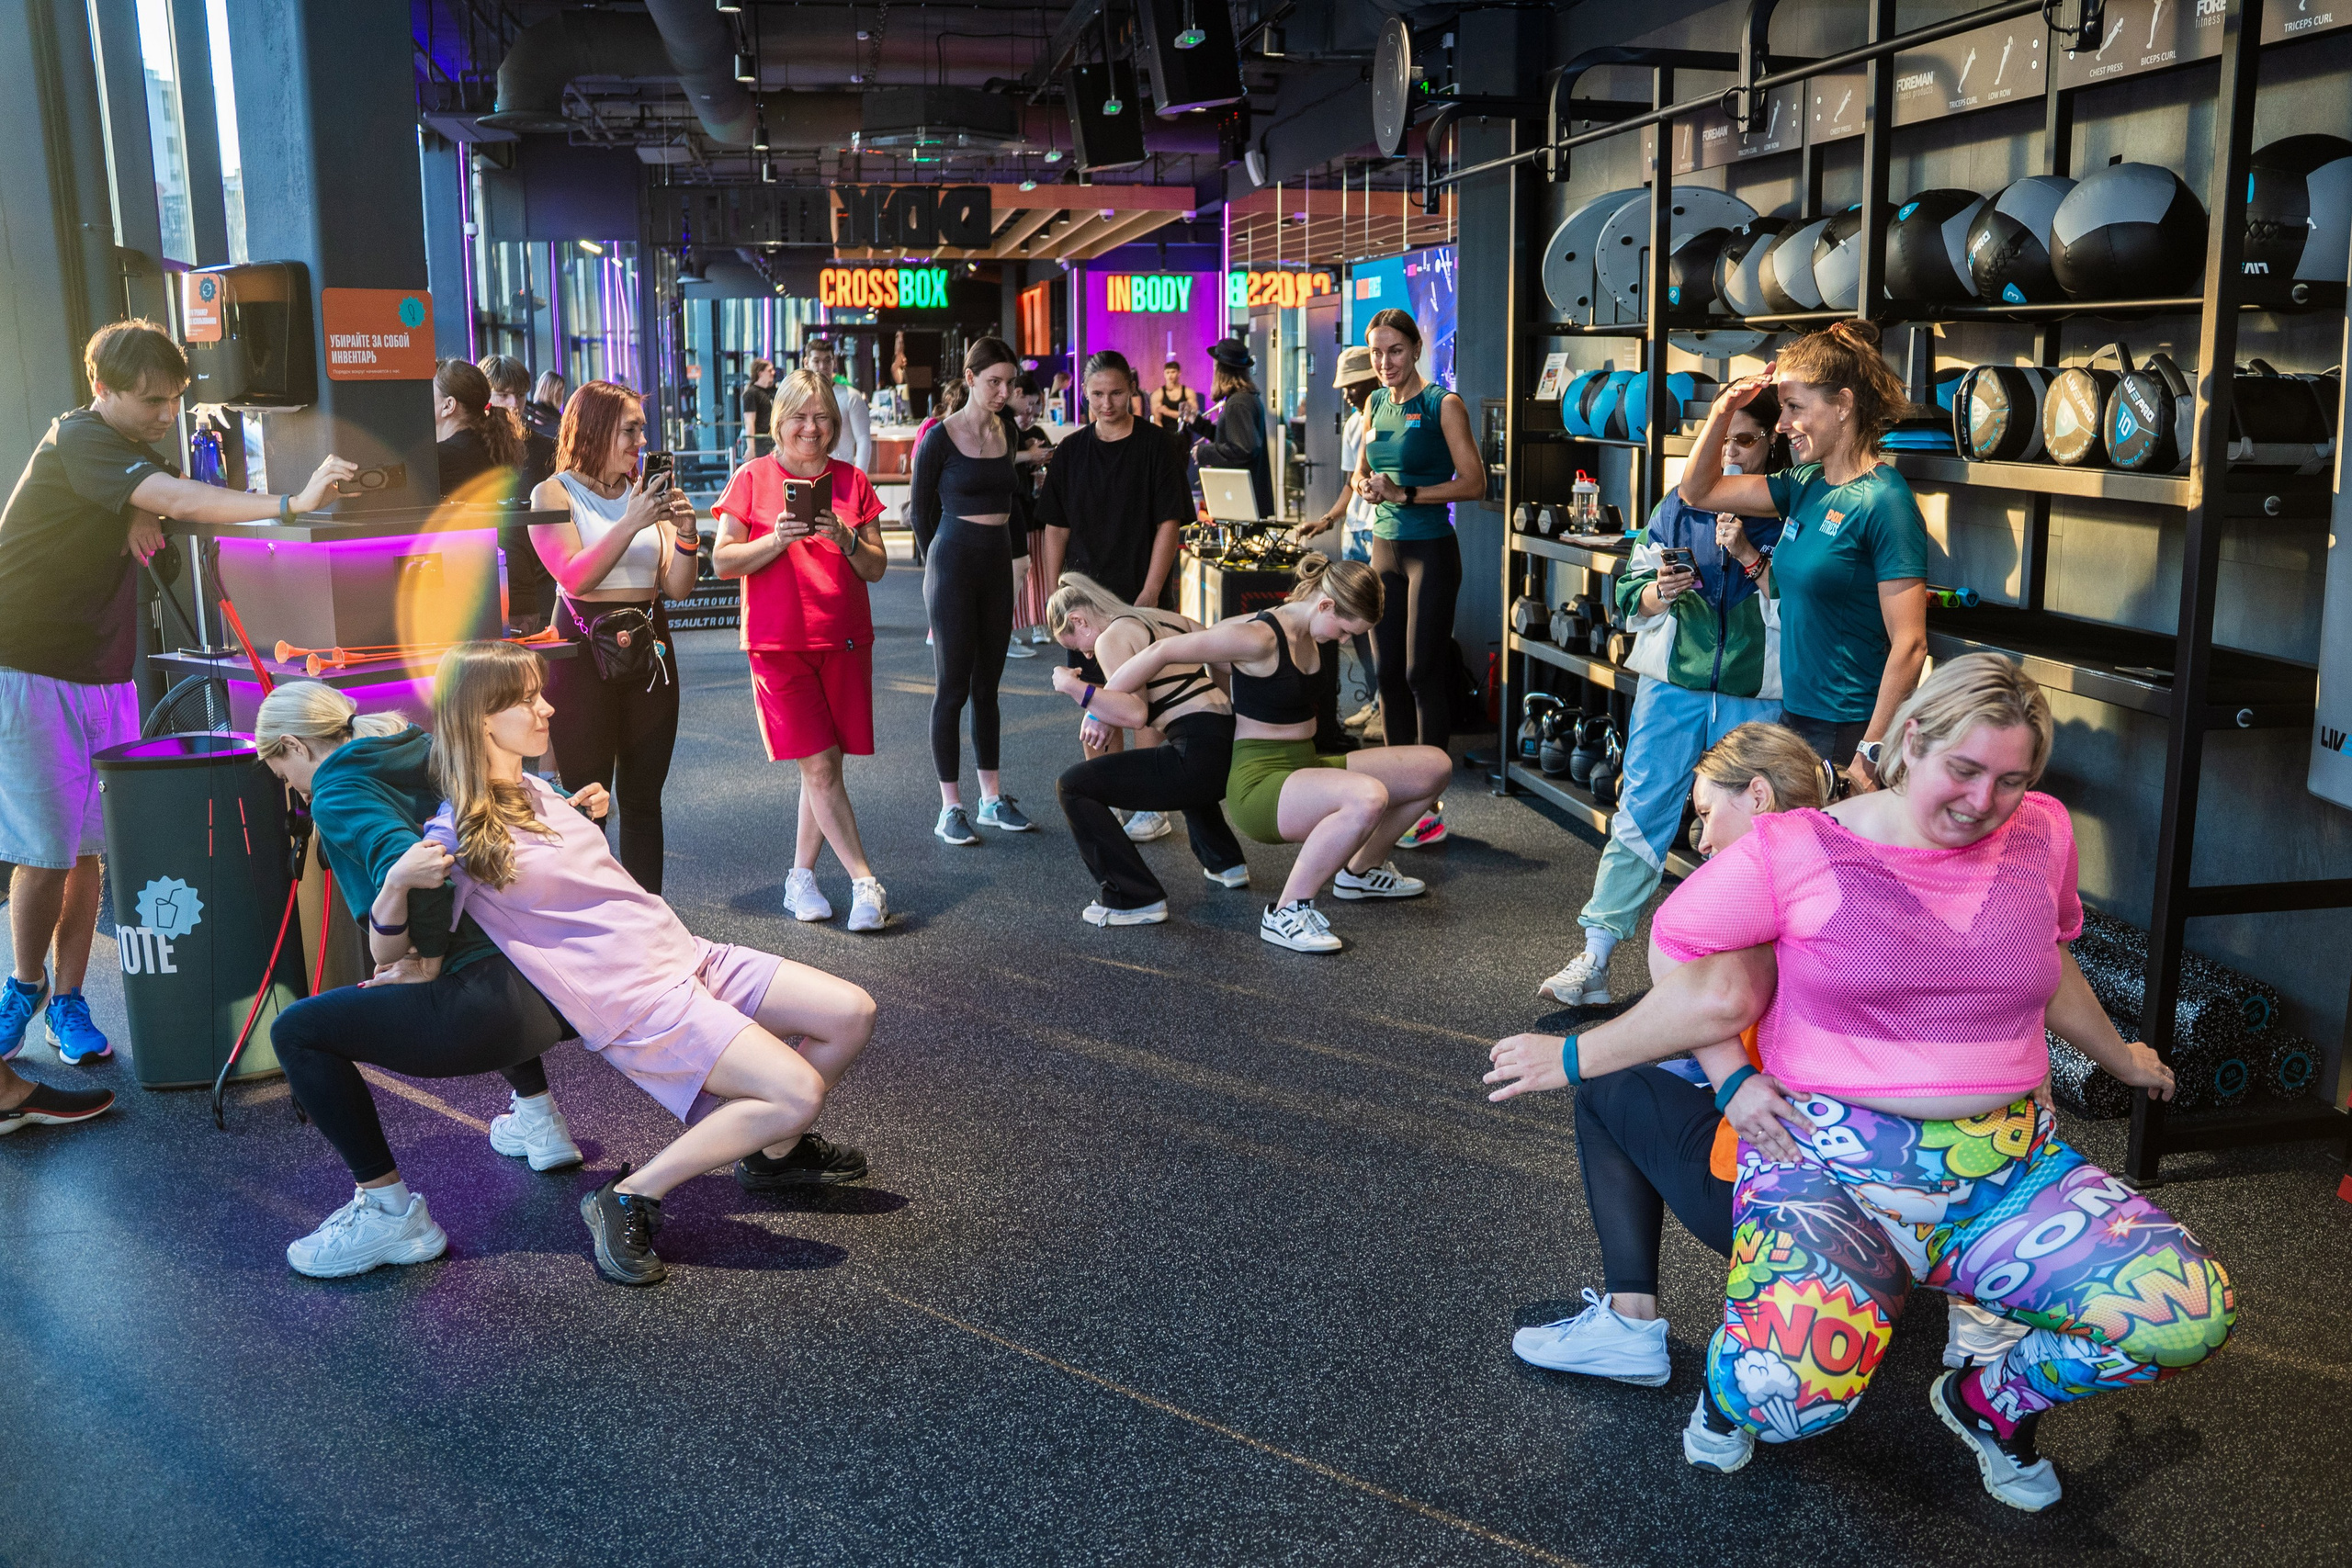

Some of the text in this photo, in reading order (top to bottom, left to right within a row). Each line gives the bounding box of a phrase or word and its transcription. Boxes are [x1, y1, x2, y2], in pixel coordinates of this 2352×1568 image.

[2195, 14, 2221, 28] fitness
[2284, 13, 2334, 33] TRICEPS CURL
[2141, 50, 2177, 66] BICEPS CURL
[2089, 62, 2123, 78] CHEST PRESS
[1895, 71, 1934, 93] FOREMAN
[1987, 87, 2012, 100] LOW ROW
[1949, 96, 1978, 109] TRICEPS CURL
[1702, 125, 1729, 142] FOREMAN
[819, 267, 949, 309] CROSSBOX
[1106, 275, 1193, 312] INBODY
[330, 332, 410, 348] УБИРАЙТЕ ЗА СОБОЙ
[332, 350, 378, 364] ИНВЕНТАРЬ
[2065, 373, 2096, 423] LIVEPRO
[2123, 375, 2155, 423] LIVEPRO
[2118, 411, 2132, 437] 10
[1825, 508, 1846, 525] DDX
[1819, 518, 1840, 537] FITNESS
[662, 596, 741, 609] SSAULTROWER
